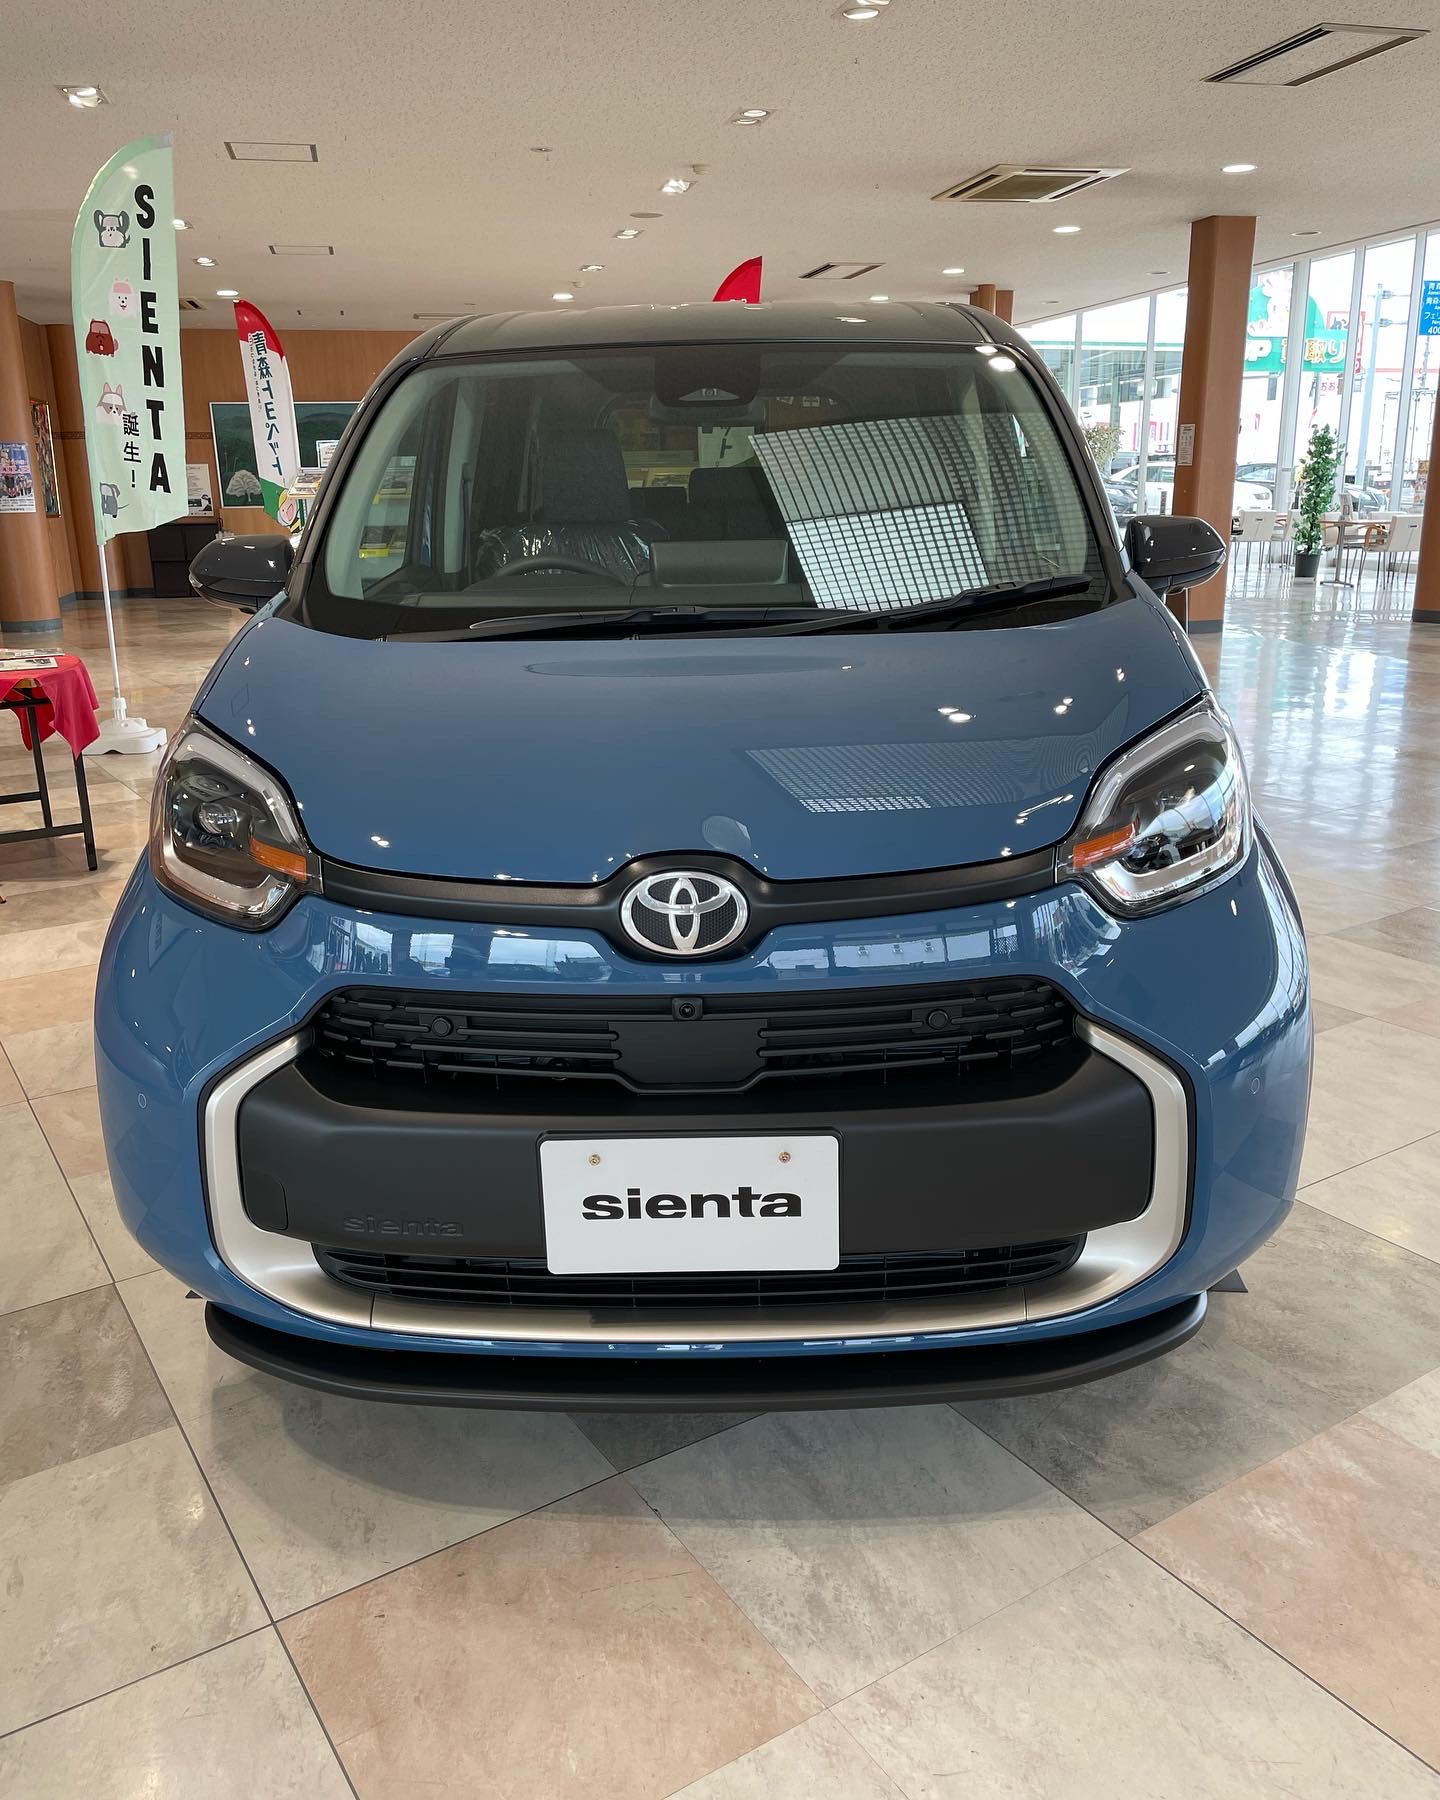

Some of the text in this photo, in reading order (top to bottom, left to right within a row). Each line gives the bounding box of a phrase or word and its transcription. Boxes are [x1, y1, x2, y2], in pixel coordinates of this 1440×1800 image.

[134, 184, 171, 493] SIENTA
[123, 412, 141, 488] 誕生!
[342, 1215, 464, 1238] sienta
[582, 1186, 802, 1220] sienta
